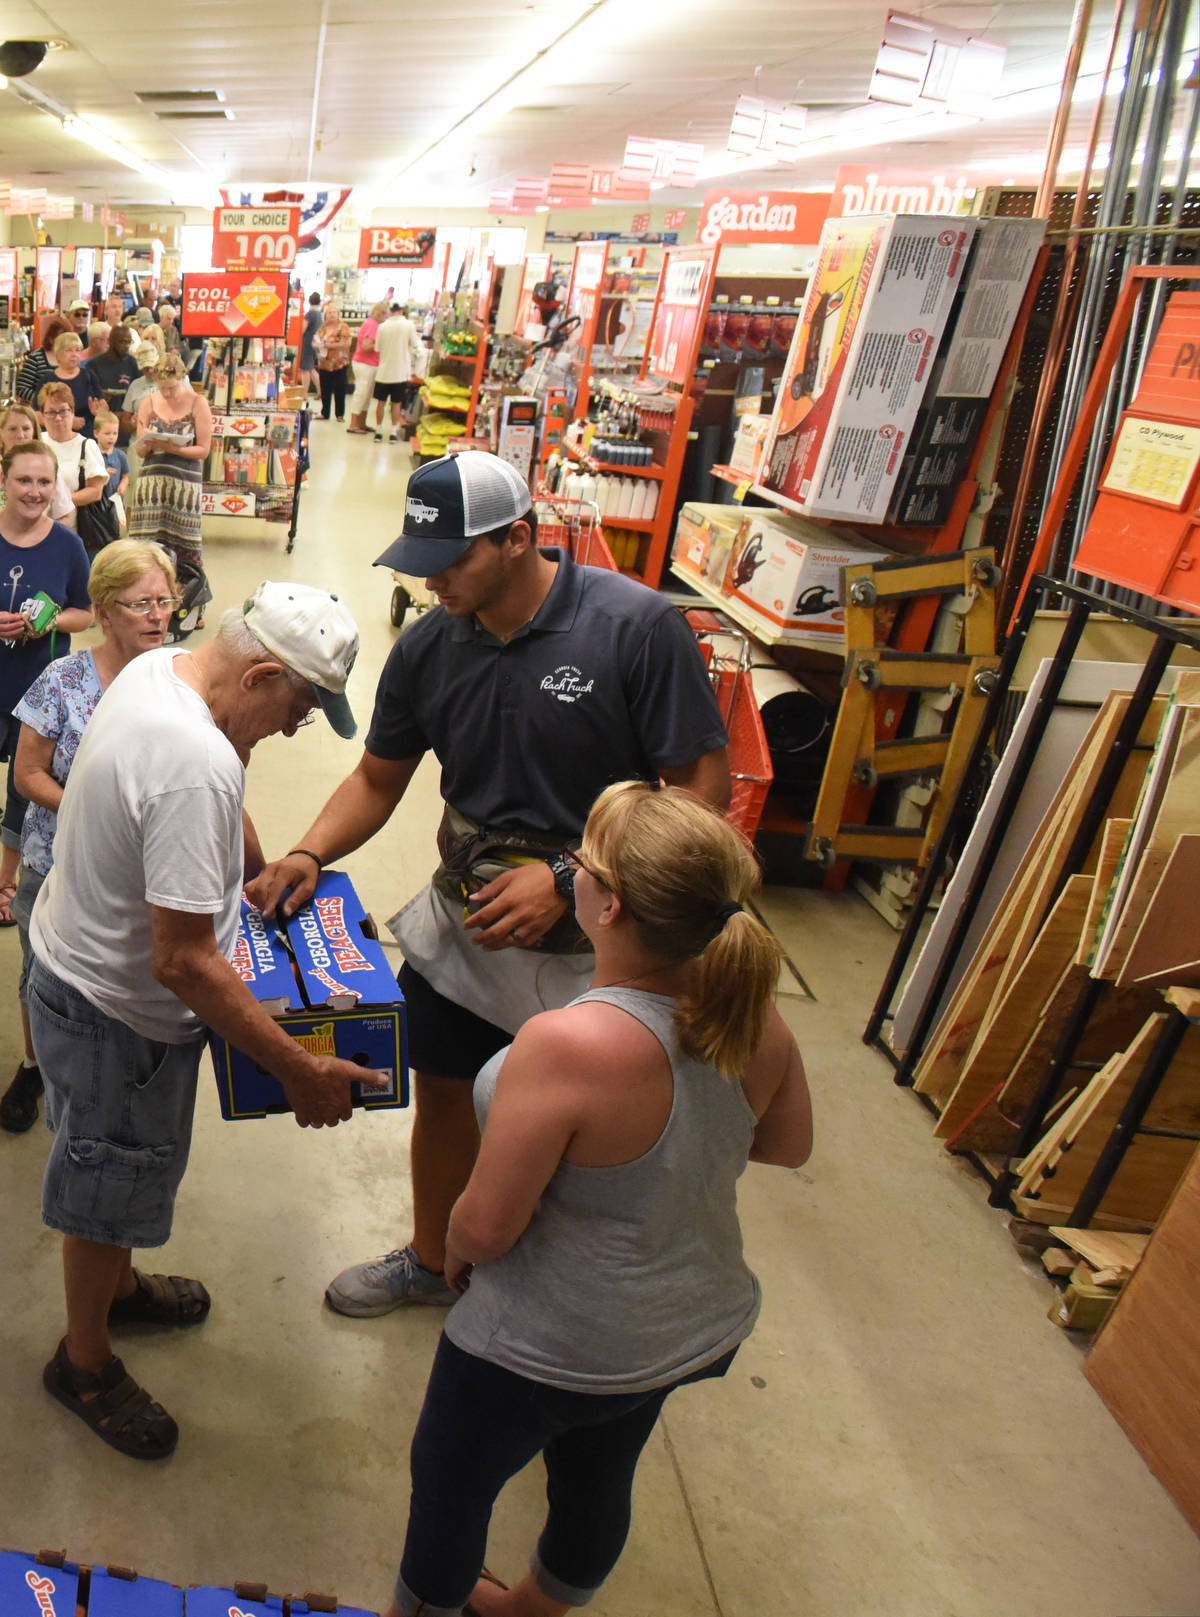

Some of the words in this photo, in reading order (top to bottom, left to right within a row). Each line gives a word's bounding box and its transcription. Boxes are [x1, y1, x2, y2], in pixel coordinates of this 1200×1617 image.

[223, 214, 245, 225] YOUR
[252, 214, 288, 225] CHOICE
[701, 196, 797, 243] garden
[187, 288, 231, 299] TOOL
[186, 301, 231, 313] SALE!
[1151, 429, 1184, 441] Plywood
[812, 553, 850, 563] Shredder
[566, 677, 594, 693] Truck
[246, 908, 277, 974] GEORGIA
[299, 905, 331, 969] GEORGIA
[314, 895, 376, 974] PEACHES
[308, 967, 363, 999] Sweet
[362, 1018, 392, 1026] Produce
[367, 1023, 376, 1031] of
[24, 1570, 57, 1617] Swe
